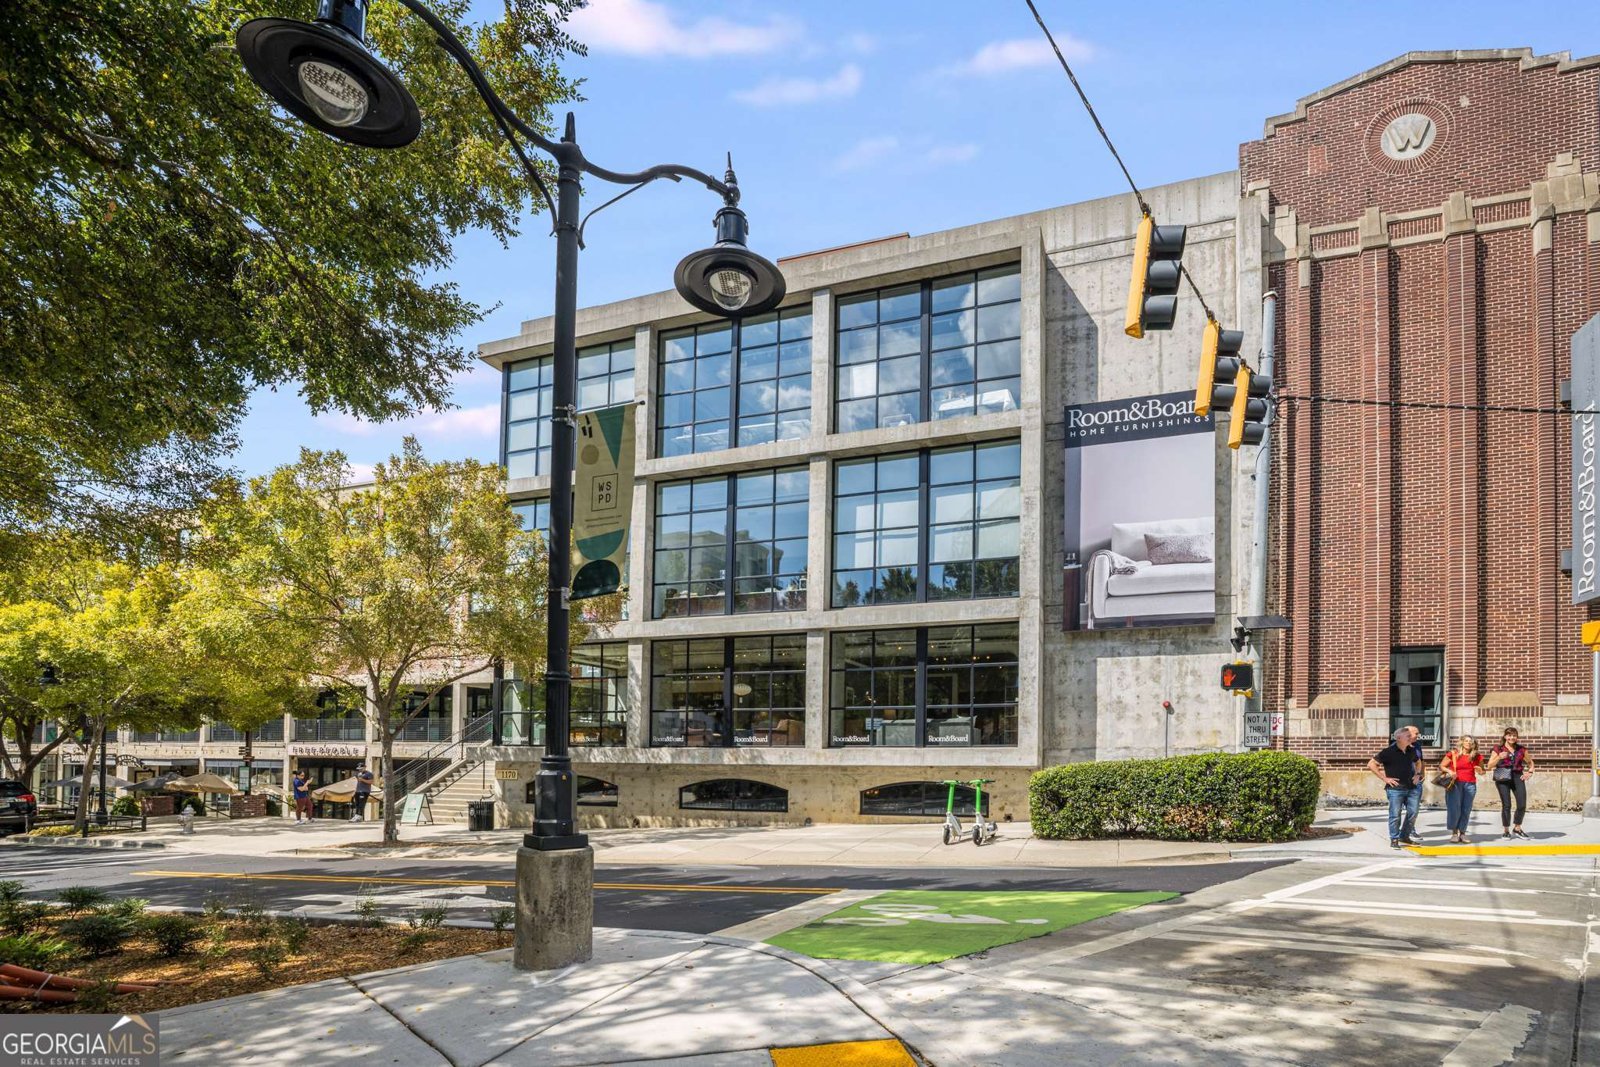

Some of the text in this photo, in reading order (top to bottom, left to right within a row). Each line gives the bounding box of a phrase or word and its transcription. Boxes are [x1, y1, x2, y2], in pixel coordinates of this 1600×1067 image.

[1386, 119, 1431, 152] W
[1068, 399, 1196, 428] Room&Boar
[1070, 416, 1209, 437] HOME FURNISHINGS
[1575, 400, 1595, 597] Room&Board
[1247, 715, 1267, 724] NOT A
[1249, 725, 1266, 734] THRU
[734, 735, 768, 743] Room&Board
[1246, 735, 1268, 744] STREET
[501, 770, 517, 779] 1170
